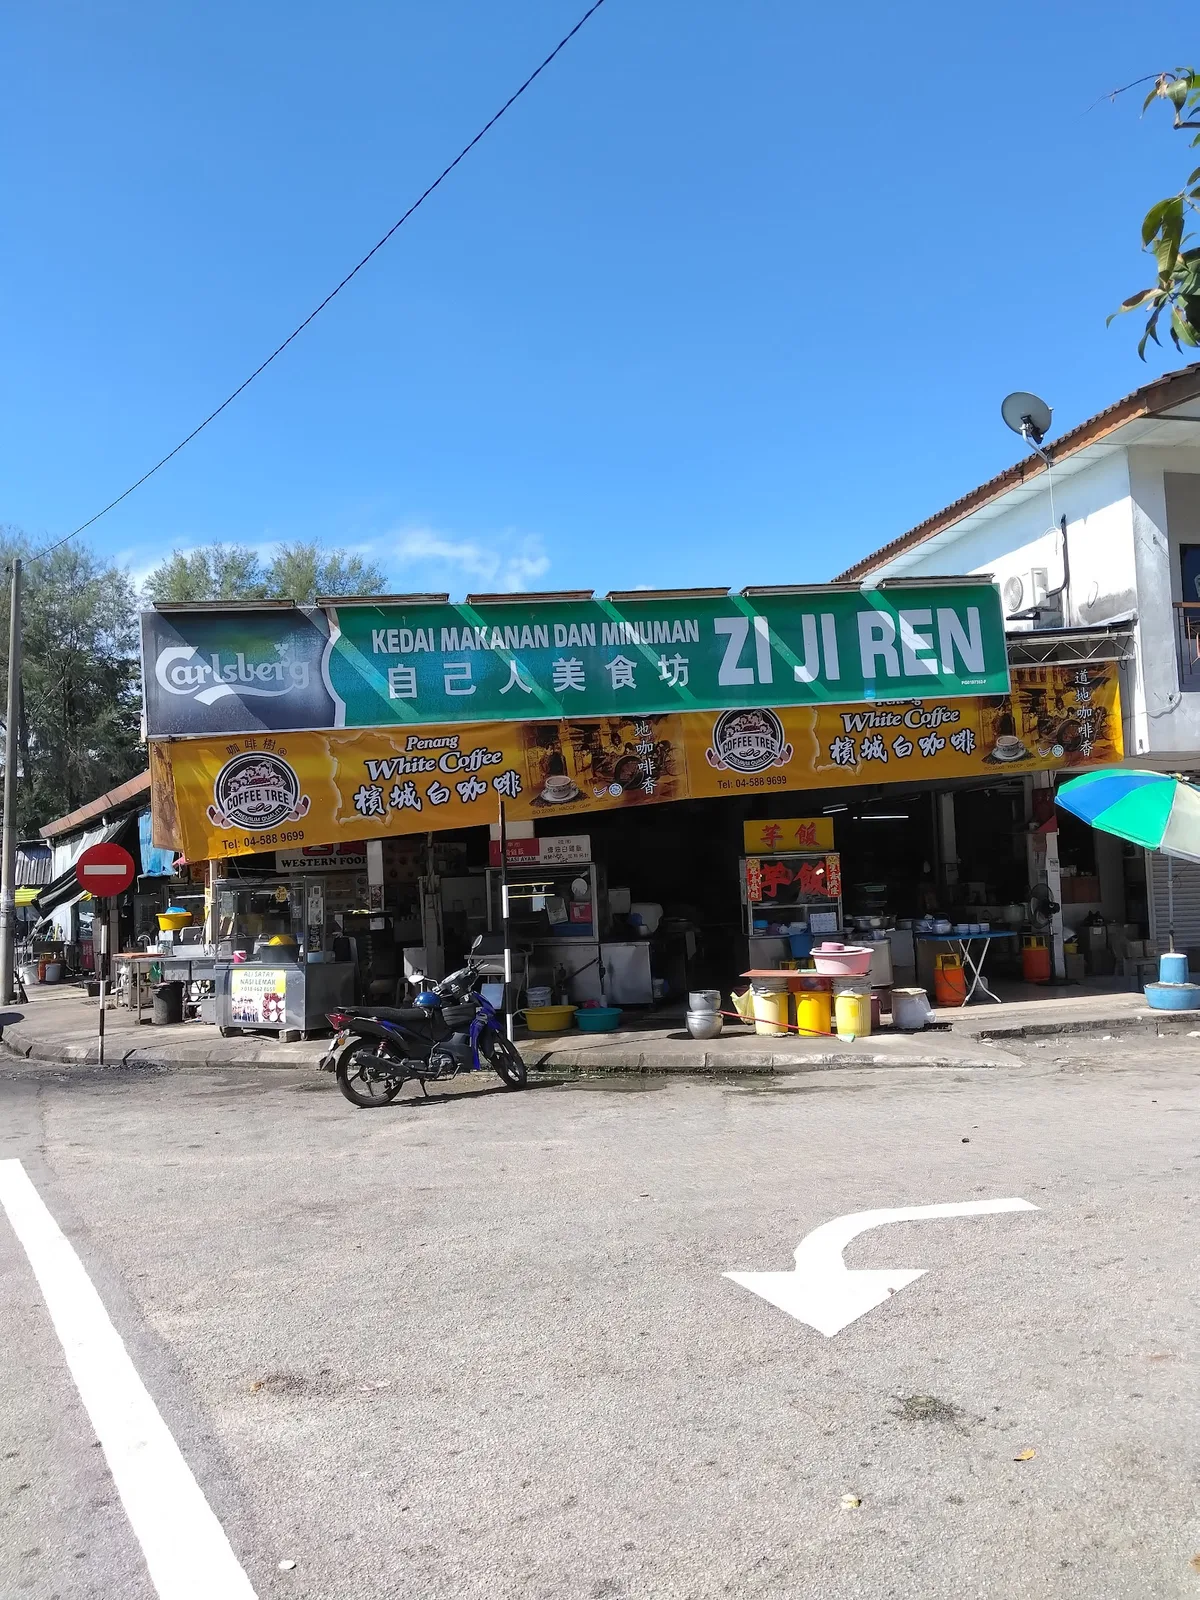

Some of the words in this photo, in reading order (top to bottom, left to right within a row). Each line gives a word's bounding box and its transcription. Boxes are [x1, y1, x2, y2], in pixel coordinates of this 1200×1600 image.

[371, 627, 435, 653] KEDAI
[440, 623, 549, 652] MAKANAN
[553, 622, 597, 648] DAN
[601, 619, 700, 646] MINUMAN
[713, 615, 773, 686] ZI
[794, 612, 841, 683] JI
[857, 606, 986, 679] REN
[155, 645, 310, 700] Carlsberg
[387, 652, 690, 699] 自己人美食坊
[841, 710, 903, 733] White
[904, 706, 961, 729] Coffee
[1074, 668, 1094, 757] 道地咖啡香
[407, 735, 459, 751] Penang
[634, 713, 658, 795] 地咖啡香
[723, 736, 752, 753] COFFEE
[755, 736, 775, 751] TREE
[829, 729, 977, 766] 檳城白咖啡
[365, 756, 437, 781] White
[439, 748, 503, 773] Coffee
[353, 770, 523, 816] 檳城白咖啡
[717, 780, 733, 789] Tel:
[735, 777, 765, 788] 04-588
[766, 775, 787, 785] 9699
[227, 789, 262, 811] COFFEE
[264, 789, 290, 806] TREE
[222, 839, 241, 850] Tel:
[244, 833, 278, 848] 04-588
[280, 830, 305, 843] 9699
[281, 857, 337, 868] WESTERN
